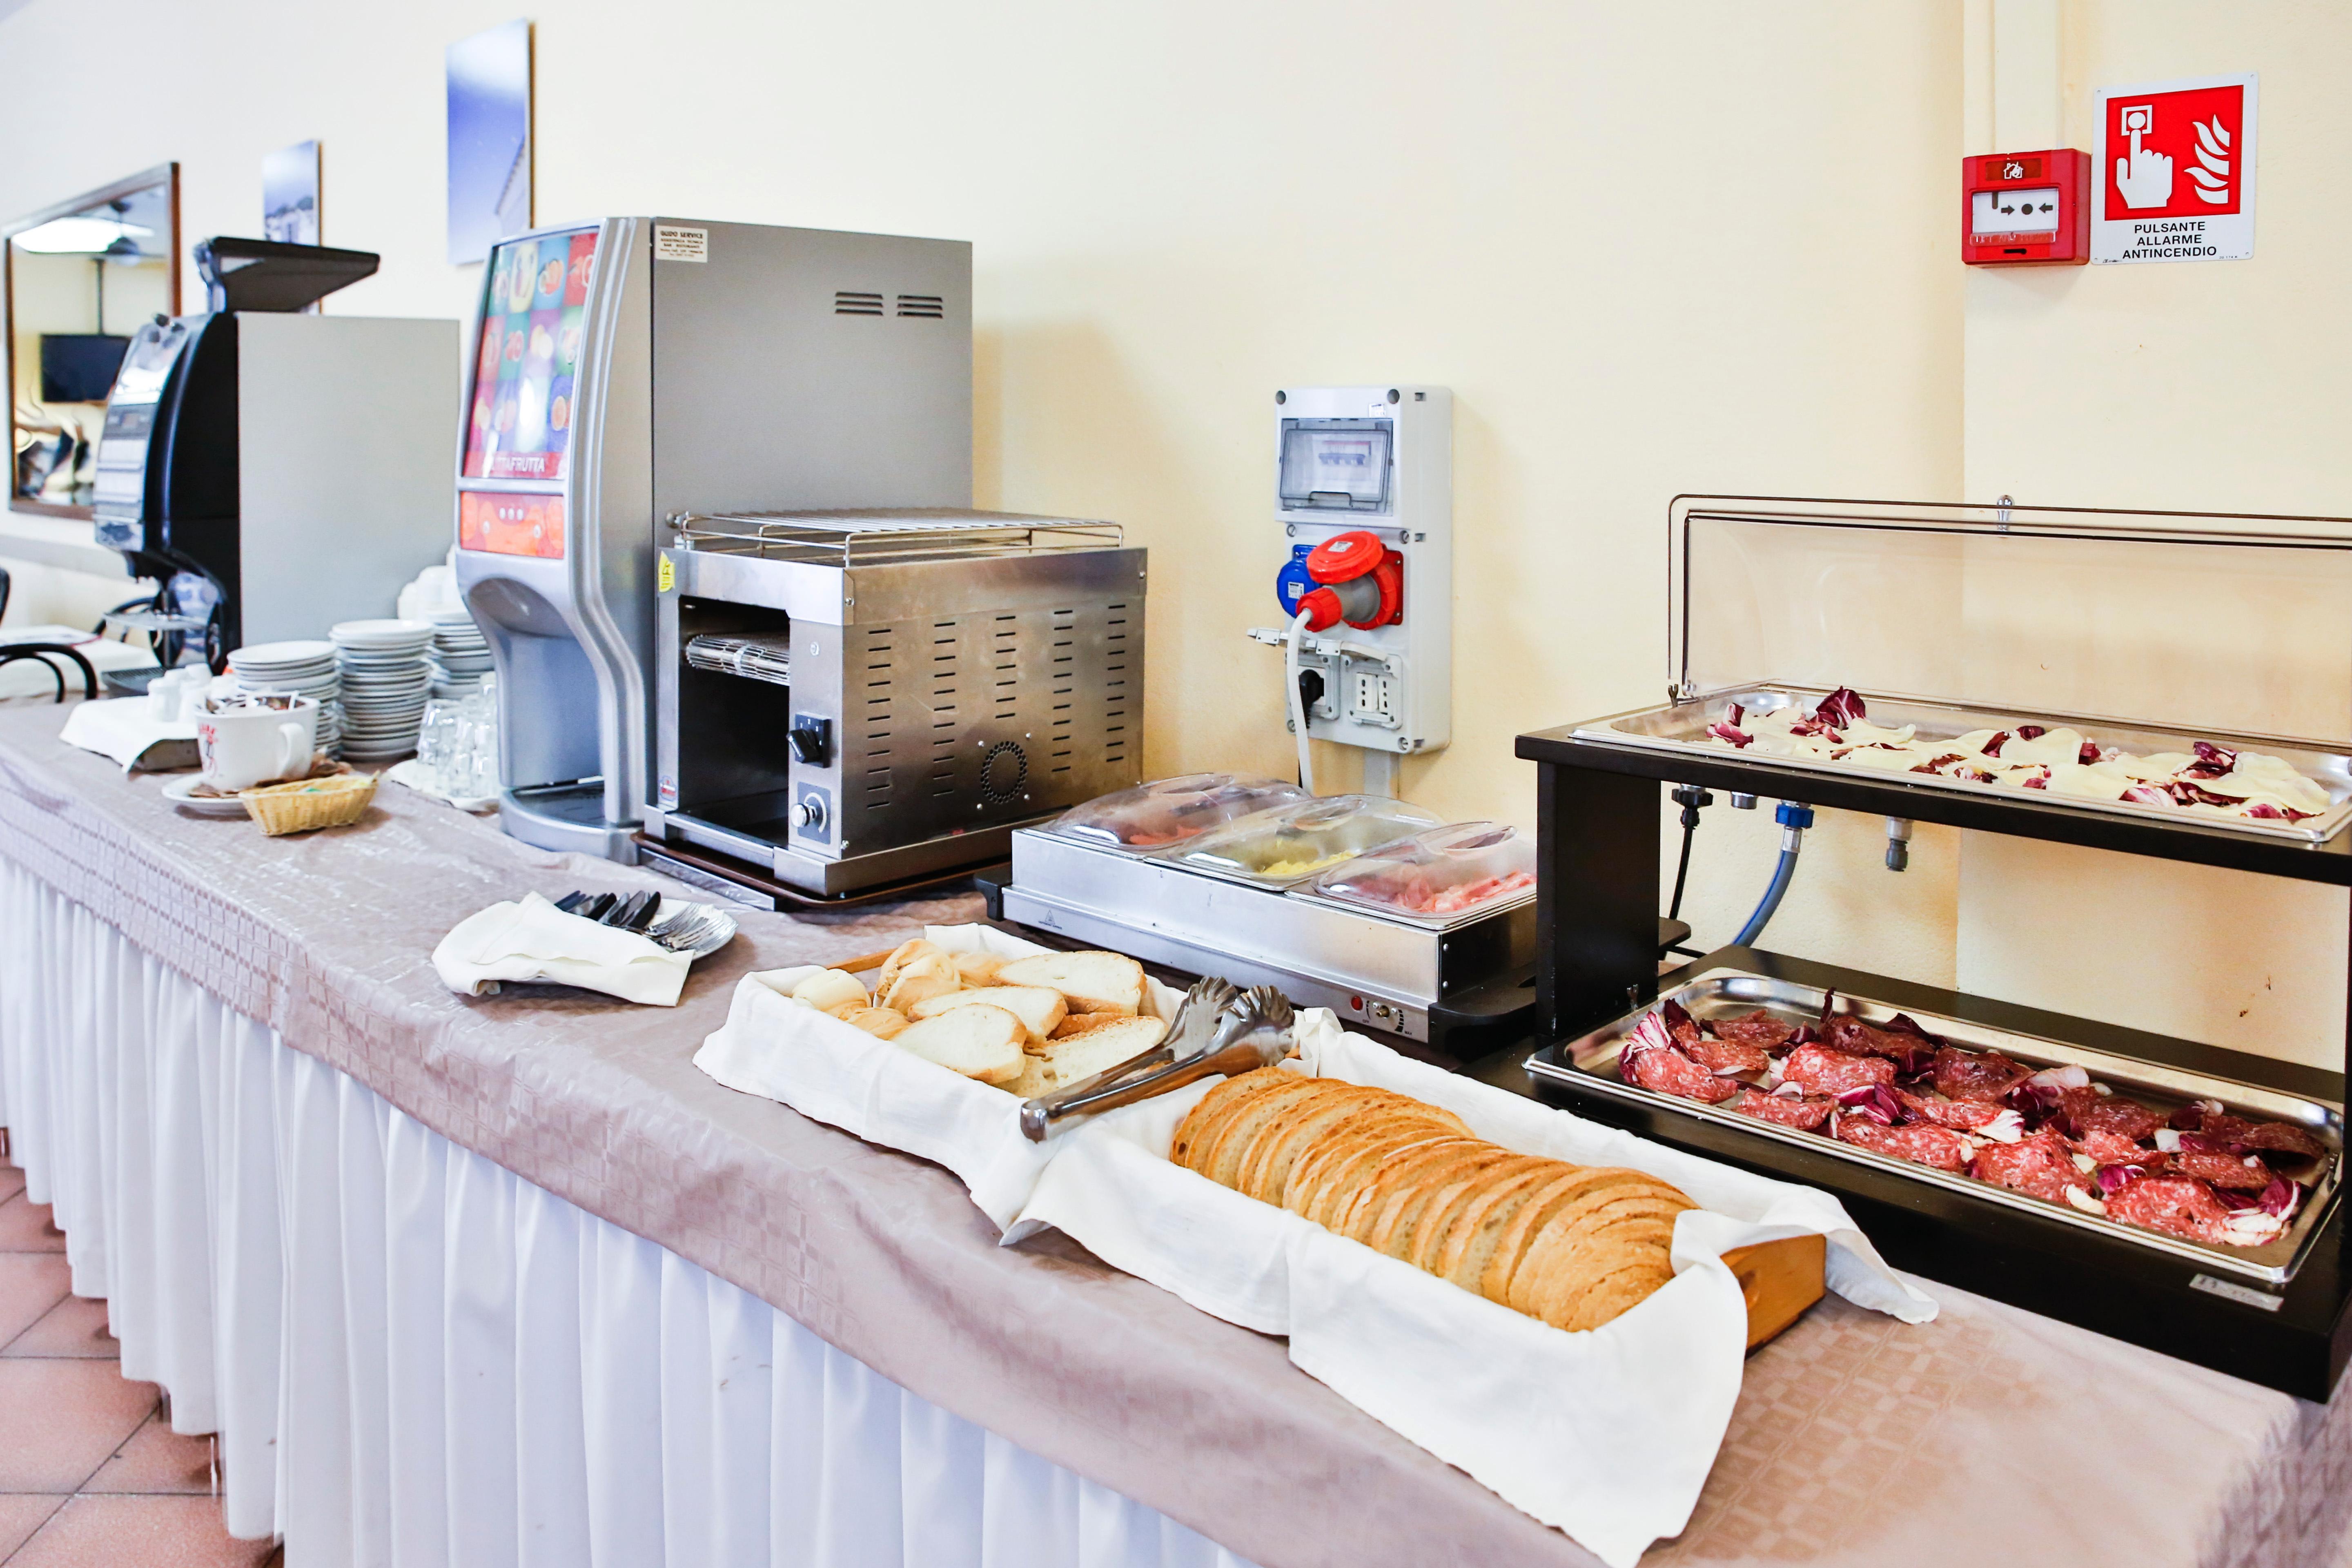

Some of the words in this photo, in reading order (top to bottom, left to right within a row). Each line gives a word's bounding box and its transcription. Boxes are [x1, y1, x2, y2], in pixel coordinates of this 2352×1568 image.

[2135, 222, 2205, 233] PULSANTE
[2137, 234, 2202, 245] ALLARME
[2123, 246, 2216, 258] ANTINCENDIO
